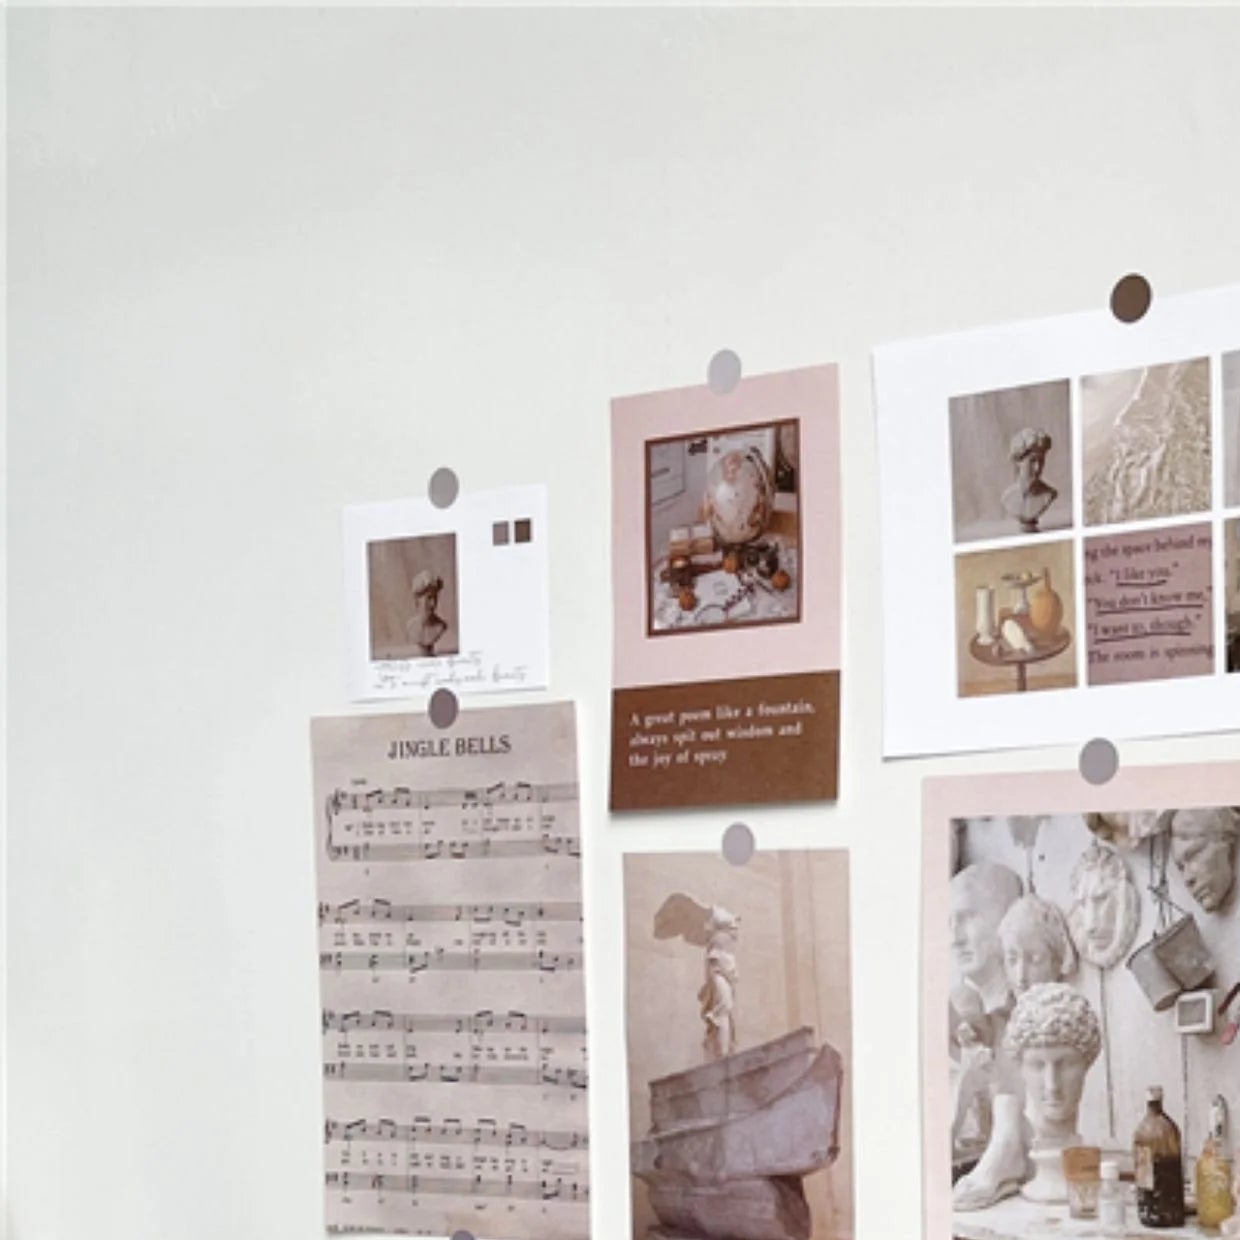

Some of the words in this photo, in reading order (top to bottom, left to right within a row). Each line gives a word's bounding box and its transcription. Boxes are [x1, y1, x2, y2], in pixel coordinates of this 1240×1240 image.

[1101, 543, 1118, 557] the
[1122, 543, 1150, 559] space
[1155, 534, 1194, 550] behind
[1124, 566, 1144, 579] like
[1151, 590, 1182, 604] know
[1100, 622, 1129, 636] want
[1088, 649, 1109, 665] The
[1112, 649, 1145, 663] room
[1150, 646, 1160, 660] is
[630, 712, 641, 726] A
[644, 710, 675, 730] great
[678, 709, 712, 727] poem
[714, 704, 741, 721] like
[745, 706, 753, 718] a
[629, 733, 669, 749] always
[672, 729, 697, 748] spit
[700, 727, 722, 743] out
[777, 721, 803, 737] and
[387, 737, 450, 762] JINGLE
[454, 733, 513, 759] BELLS
[628, 752, 650, 769] the
[652, 751, 672, 769] joy
[675, 749, 691, 764] of
